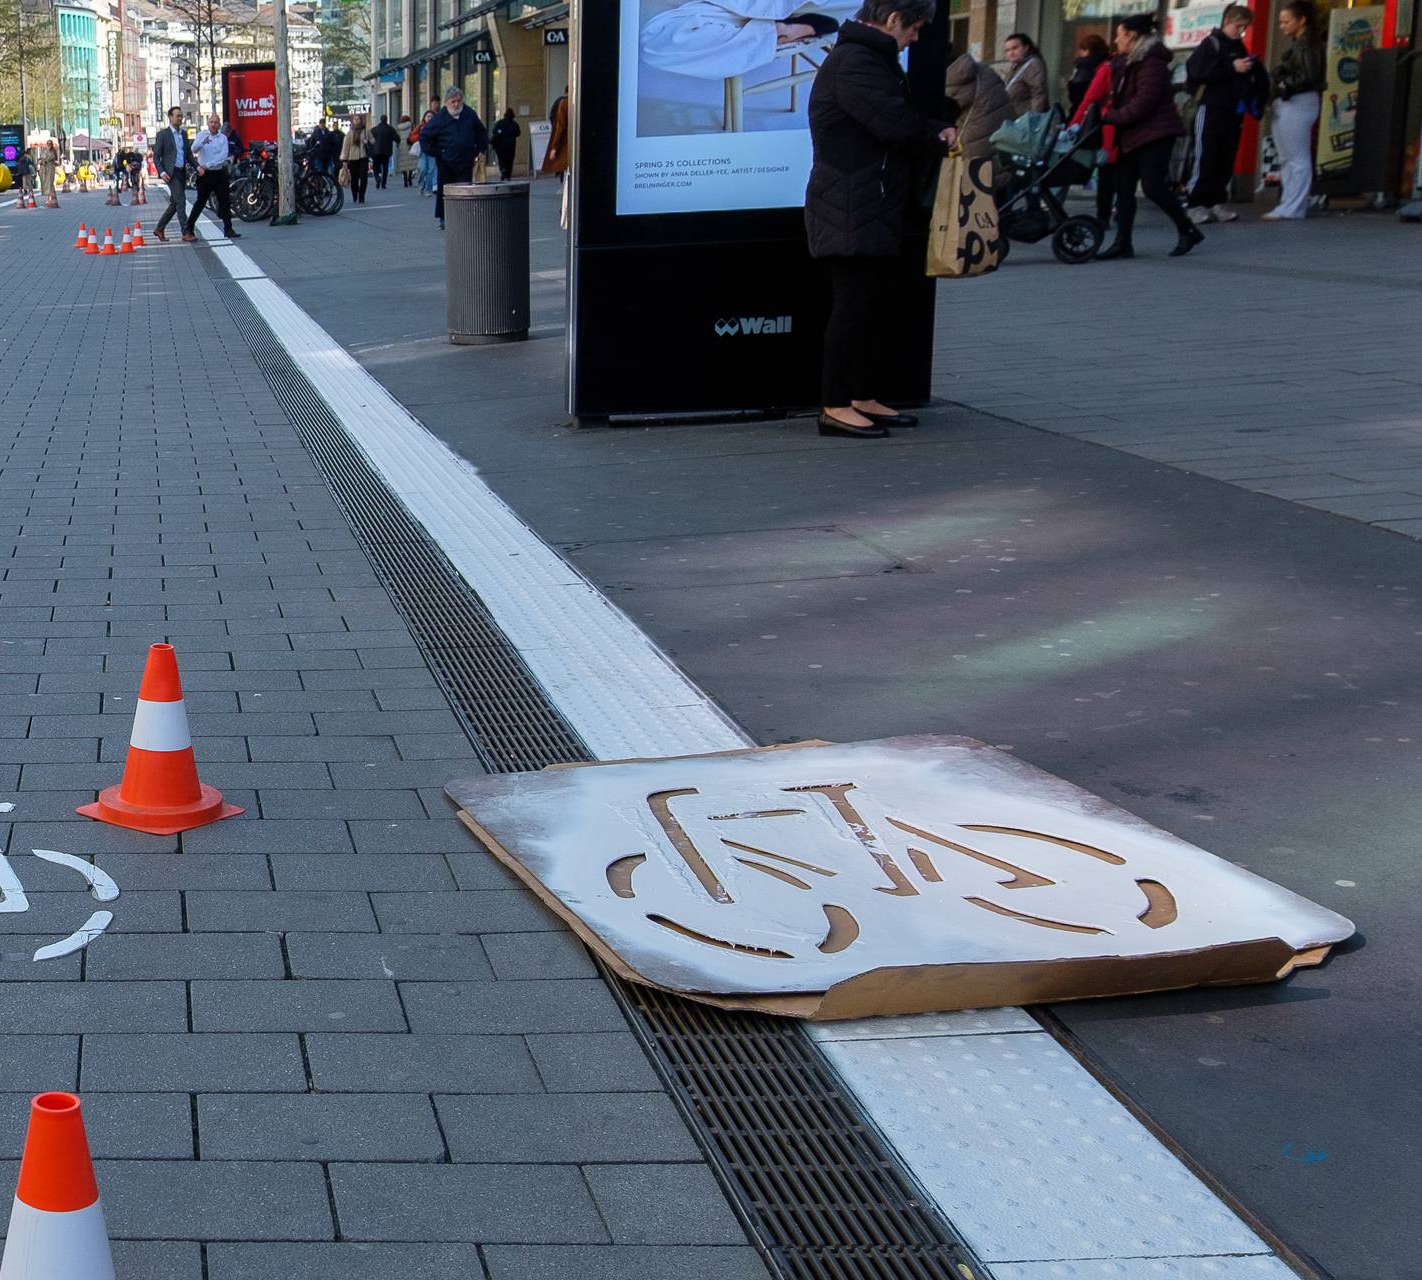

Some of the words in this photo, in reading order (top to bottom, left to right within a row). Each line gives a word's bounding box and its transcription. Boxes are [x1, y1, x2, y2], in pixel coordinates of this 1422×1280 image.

[235, 98, 258, 109] Wir
[347, 104, 370, 114] WELT
[676, 158, 731, 167] COLLECTIONS
[739, 316, 792, 334] Wall
